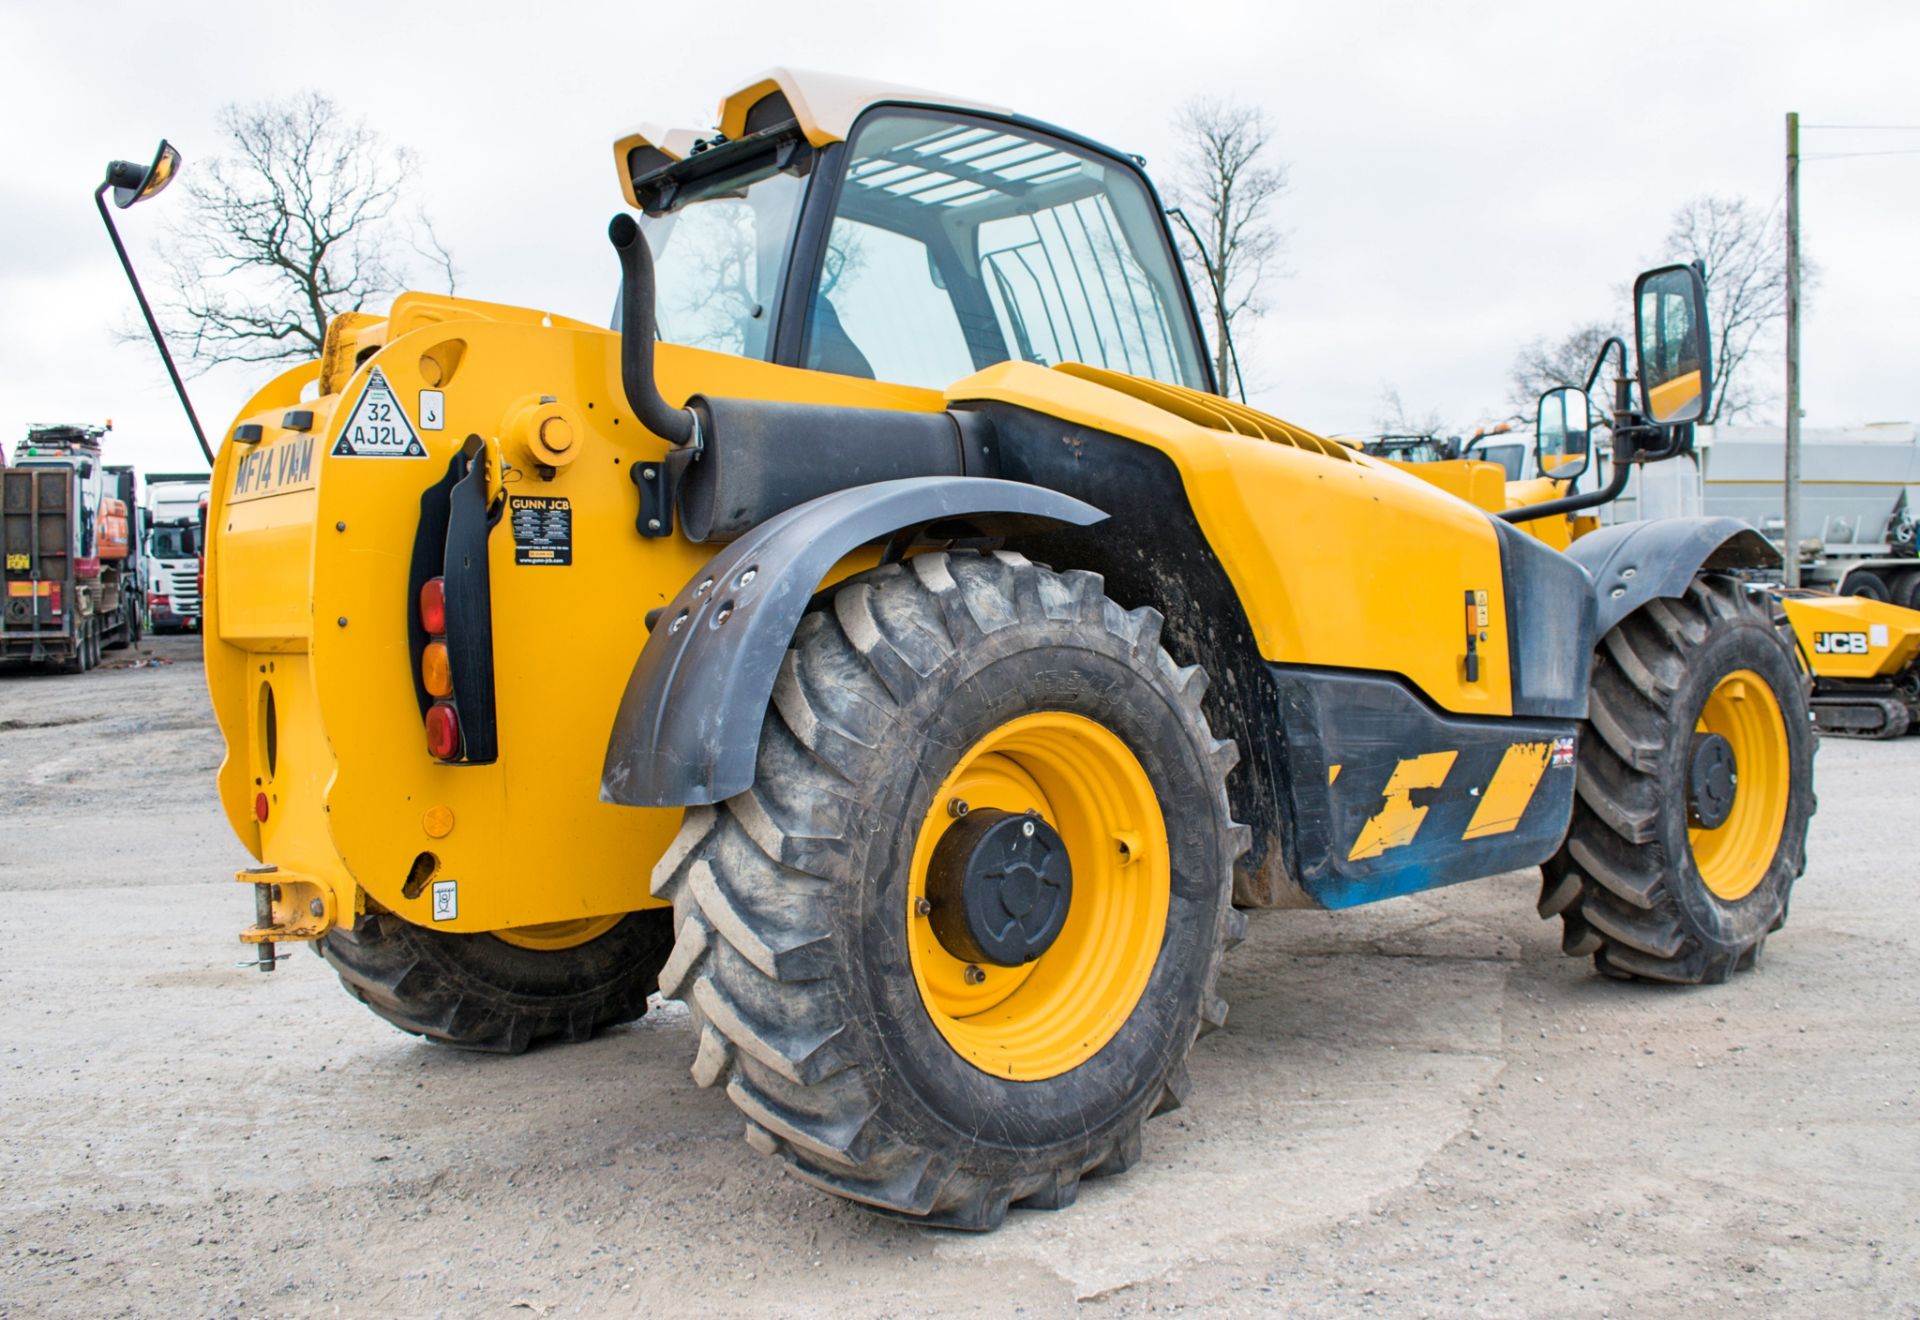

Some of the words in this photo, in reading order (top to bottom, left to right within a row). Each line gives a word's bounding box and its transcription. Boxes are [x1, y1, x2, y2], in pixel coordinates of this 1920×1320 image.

[368, 403, 391, 422] 32
[354, 426, 404, 445] AJ2L
[234, 448, 274, 495] MF14
[512, 499, 546, 509] GUNN
[548, 500, 570, 510] JCB
[1815, 632, 1868, 654] JCB
